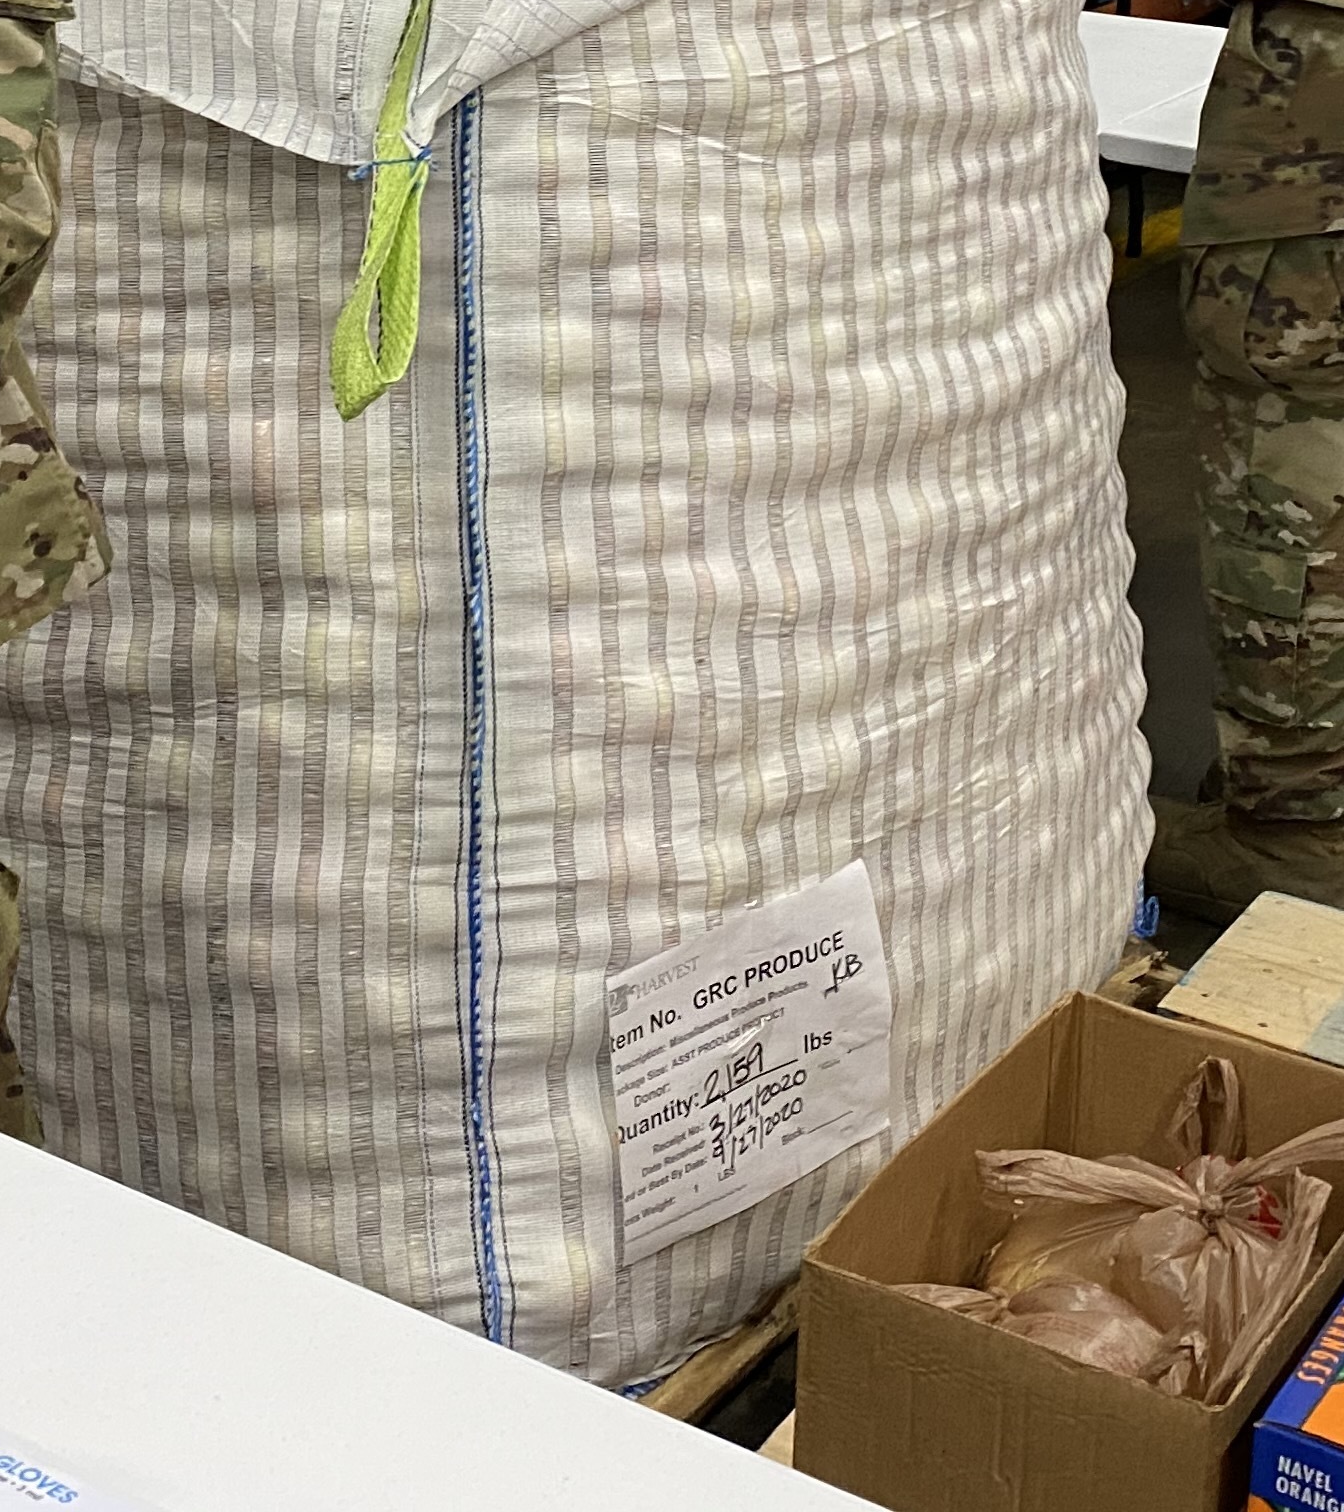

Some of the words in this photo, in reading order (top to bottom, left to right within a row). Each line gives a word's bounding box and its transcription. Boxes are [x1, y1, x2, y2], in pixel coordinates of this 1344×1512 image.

[610, 1023, 644, 1053] tem
[650, 1008, 682, 1034] No.
[693, 975, 739, 1010] GRC
[745, 930, 845, 988] PRODUCE
[803, 1030, 834, 1055] lbs
[1277, 1453, 1334, 1492] NAVEL
